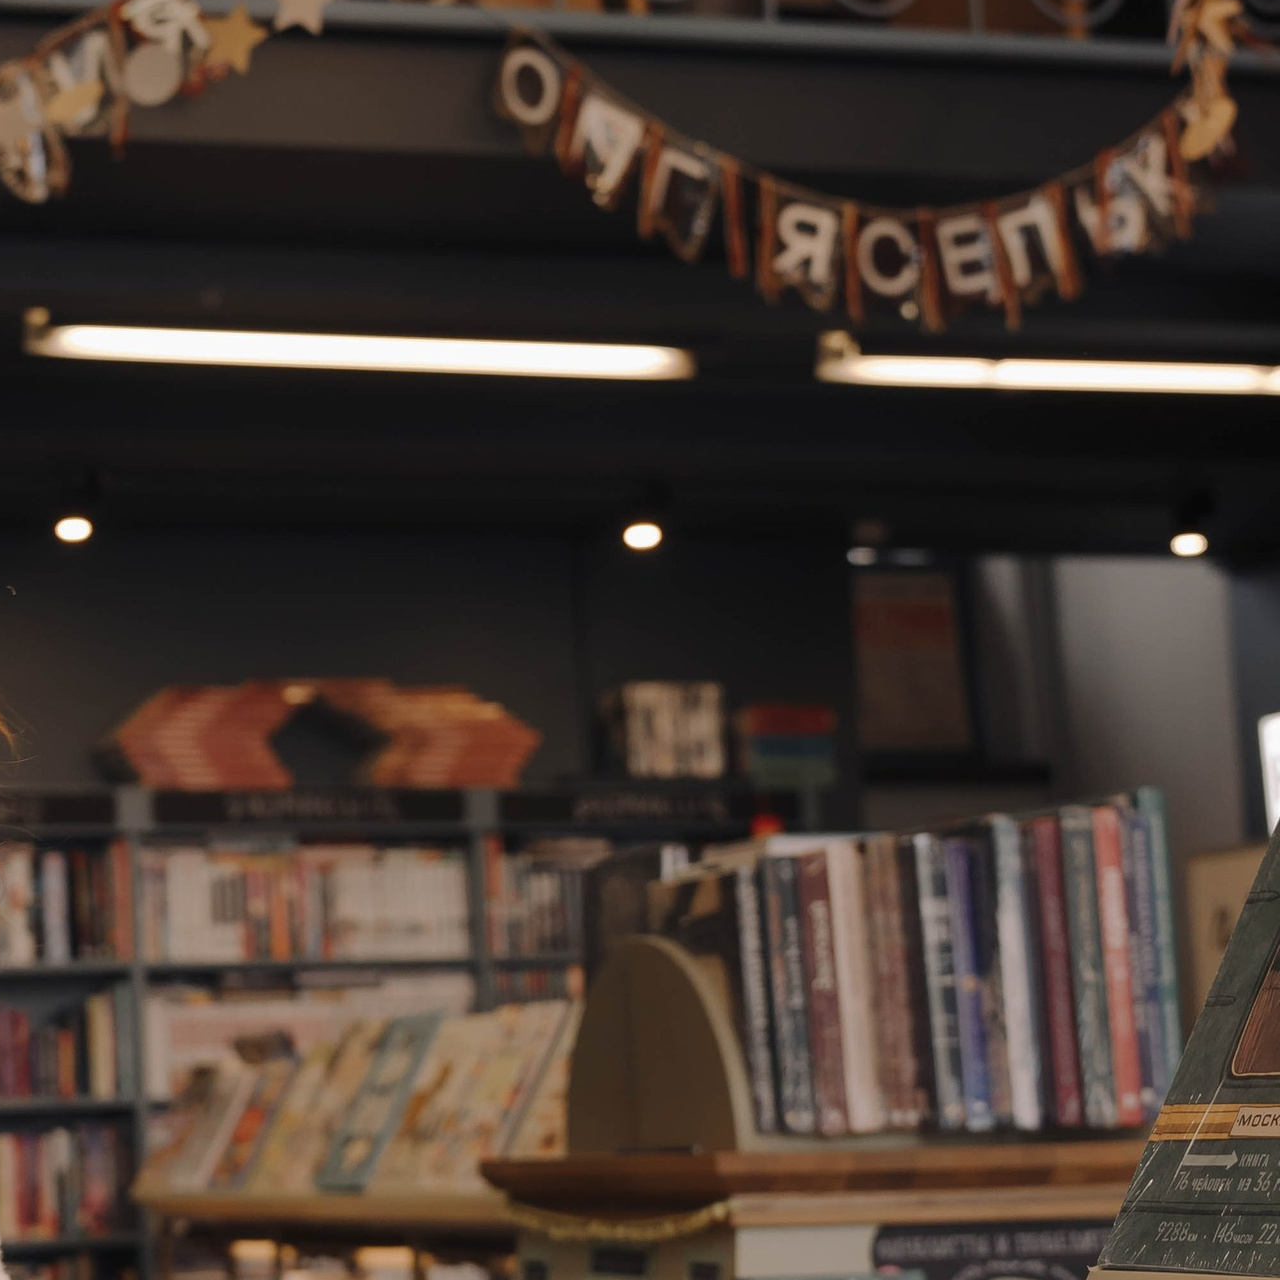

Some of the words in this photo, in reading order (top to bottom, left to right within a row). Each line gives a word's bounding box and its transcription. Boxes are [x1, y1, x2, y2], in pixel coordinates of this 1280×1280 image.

[1237, 1113, 1280, 1127] МОСК
[1238, 1153, 1270, 1167] КНИГА
[1174, 1171, 1191, 1191] 76
[1236, 1178, 1252, 1192] ИЗ
[1253, 1171, 1274, 1192] 36
